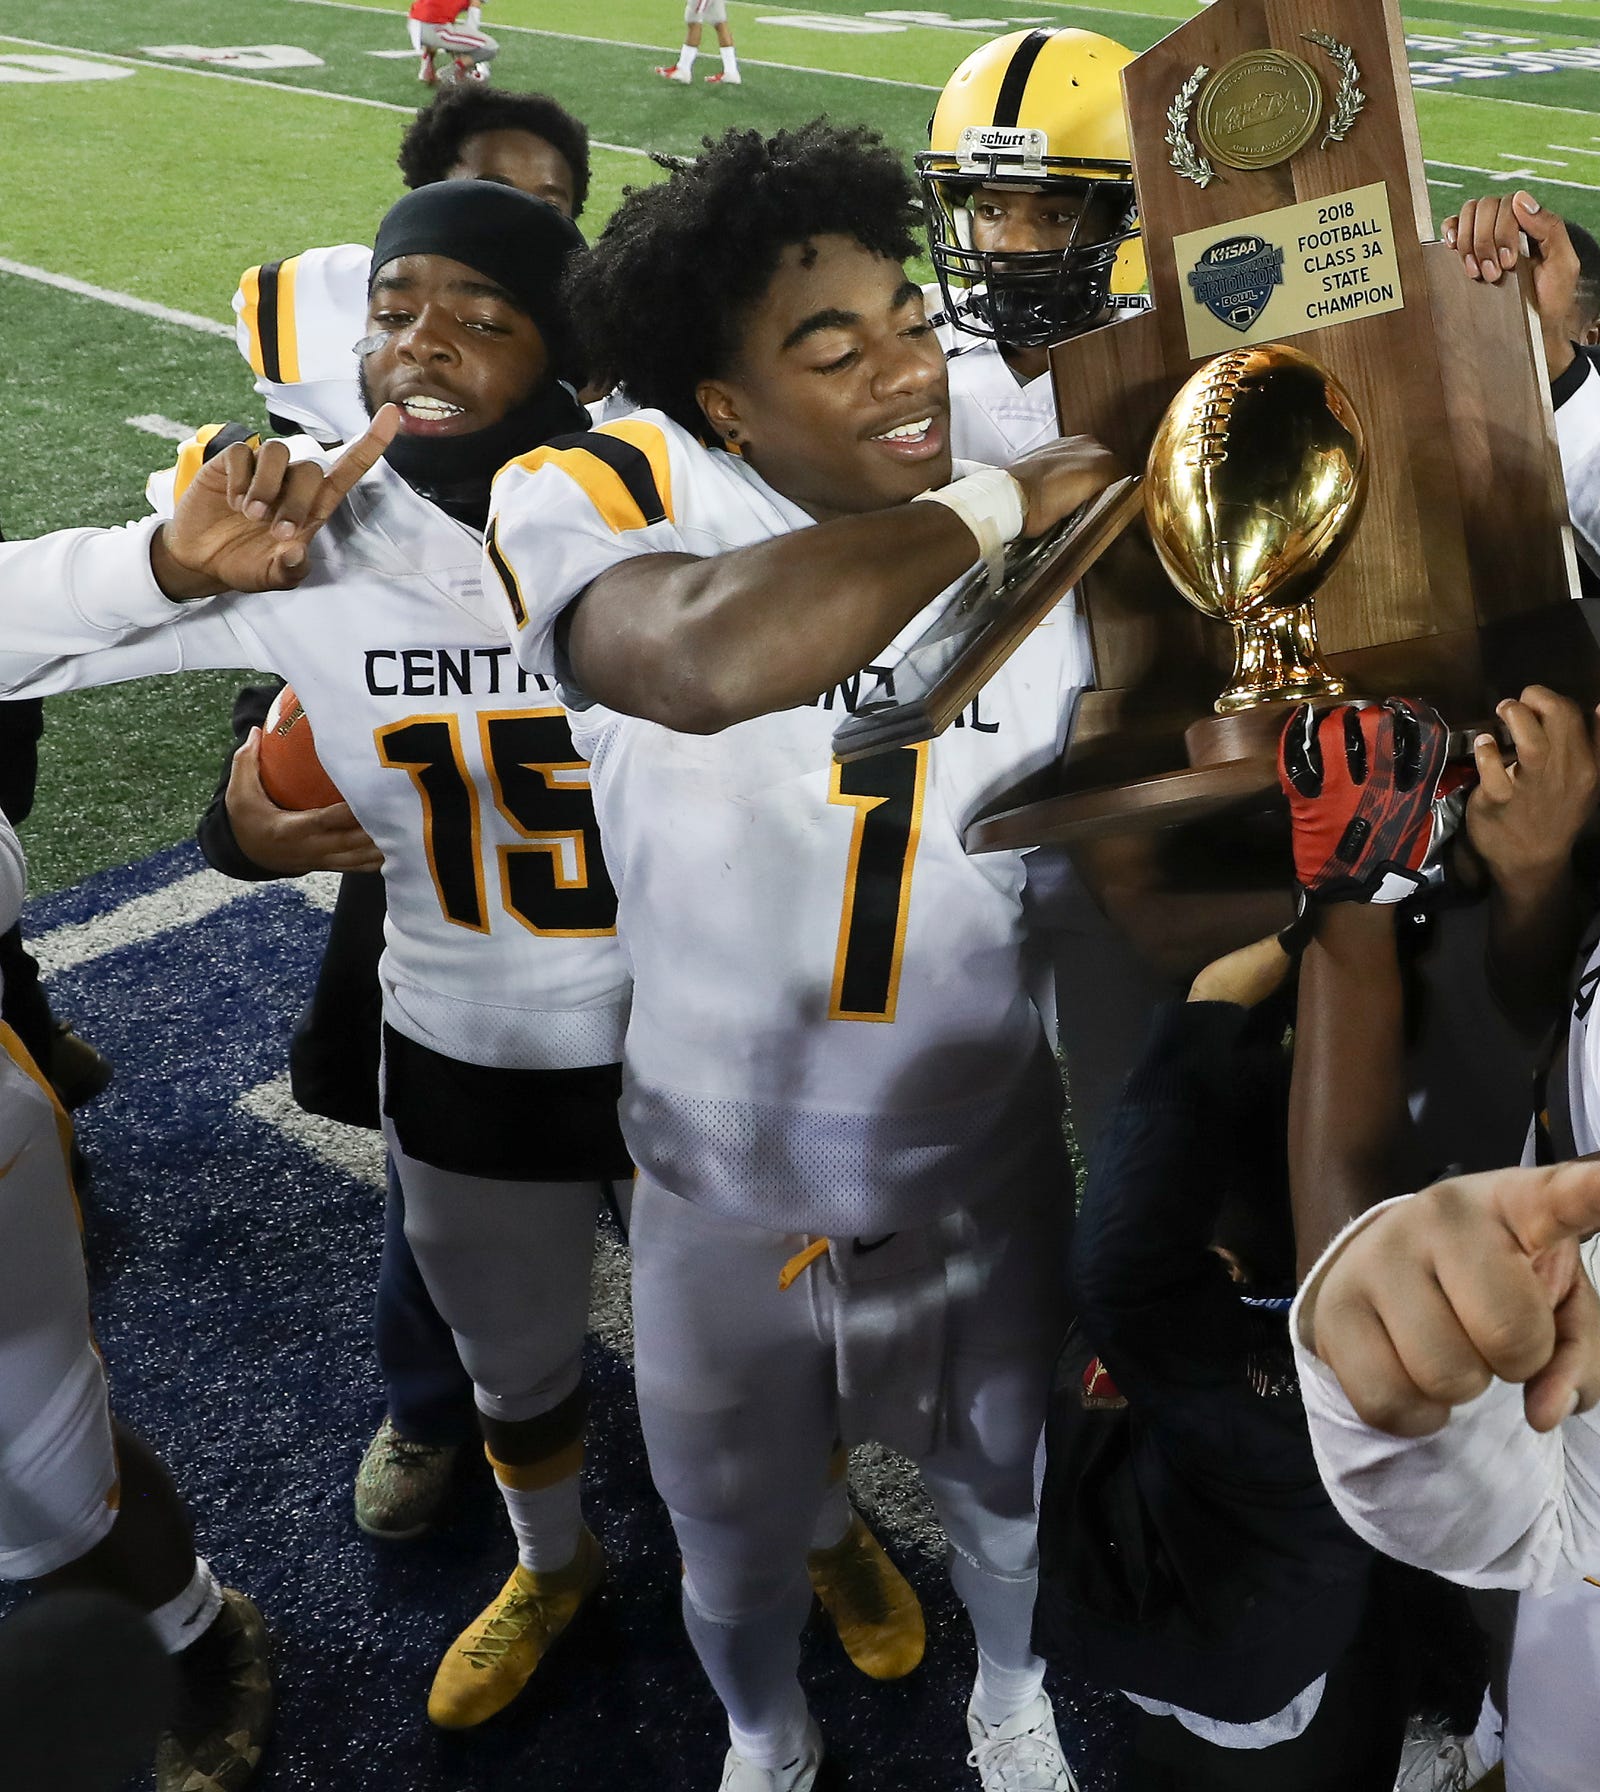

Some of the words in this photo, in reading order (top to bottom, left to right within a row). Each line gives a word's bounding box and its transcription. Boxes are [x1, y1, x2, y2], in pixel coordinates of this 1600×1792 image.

[980, 131, 1025, 147] schutt
[1317, 202, 1354, 224] 2018
[1298, 219, 1382, 252] FOOTBALL
[1210, 239, 1258, 264] KHSAA
[1304, 248, 1356, 273] CLASS
[1362, 241, 1383, 259] 3A
[1322, 267, 1370, 292] STATE
[1222, 290, 1259, 307] BOWL
[1306, 284, 1393, 319] CHAMPION
[373, 707, 619, 937] 15
[828, 741, 930, 1022] 1
